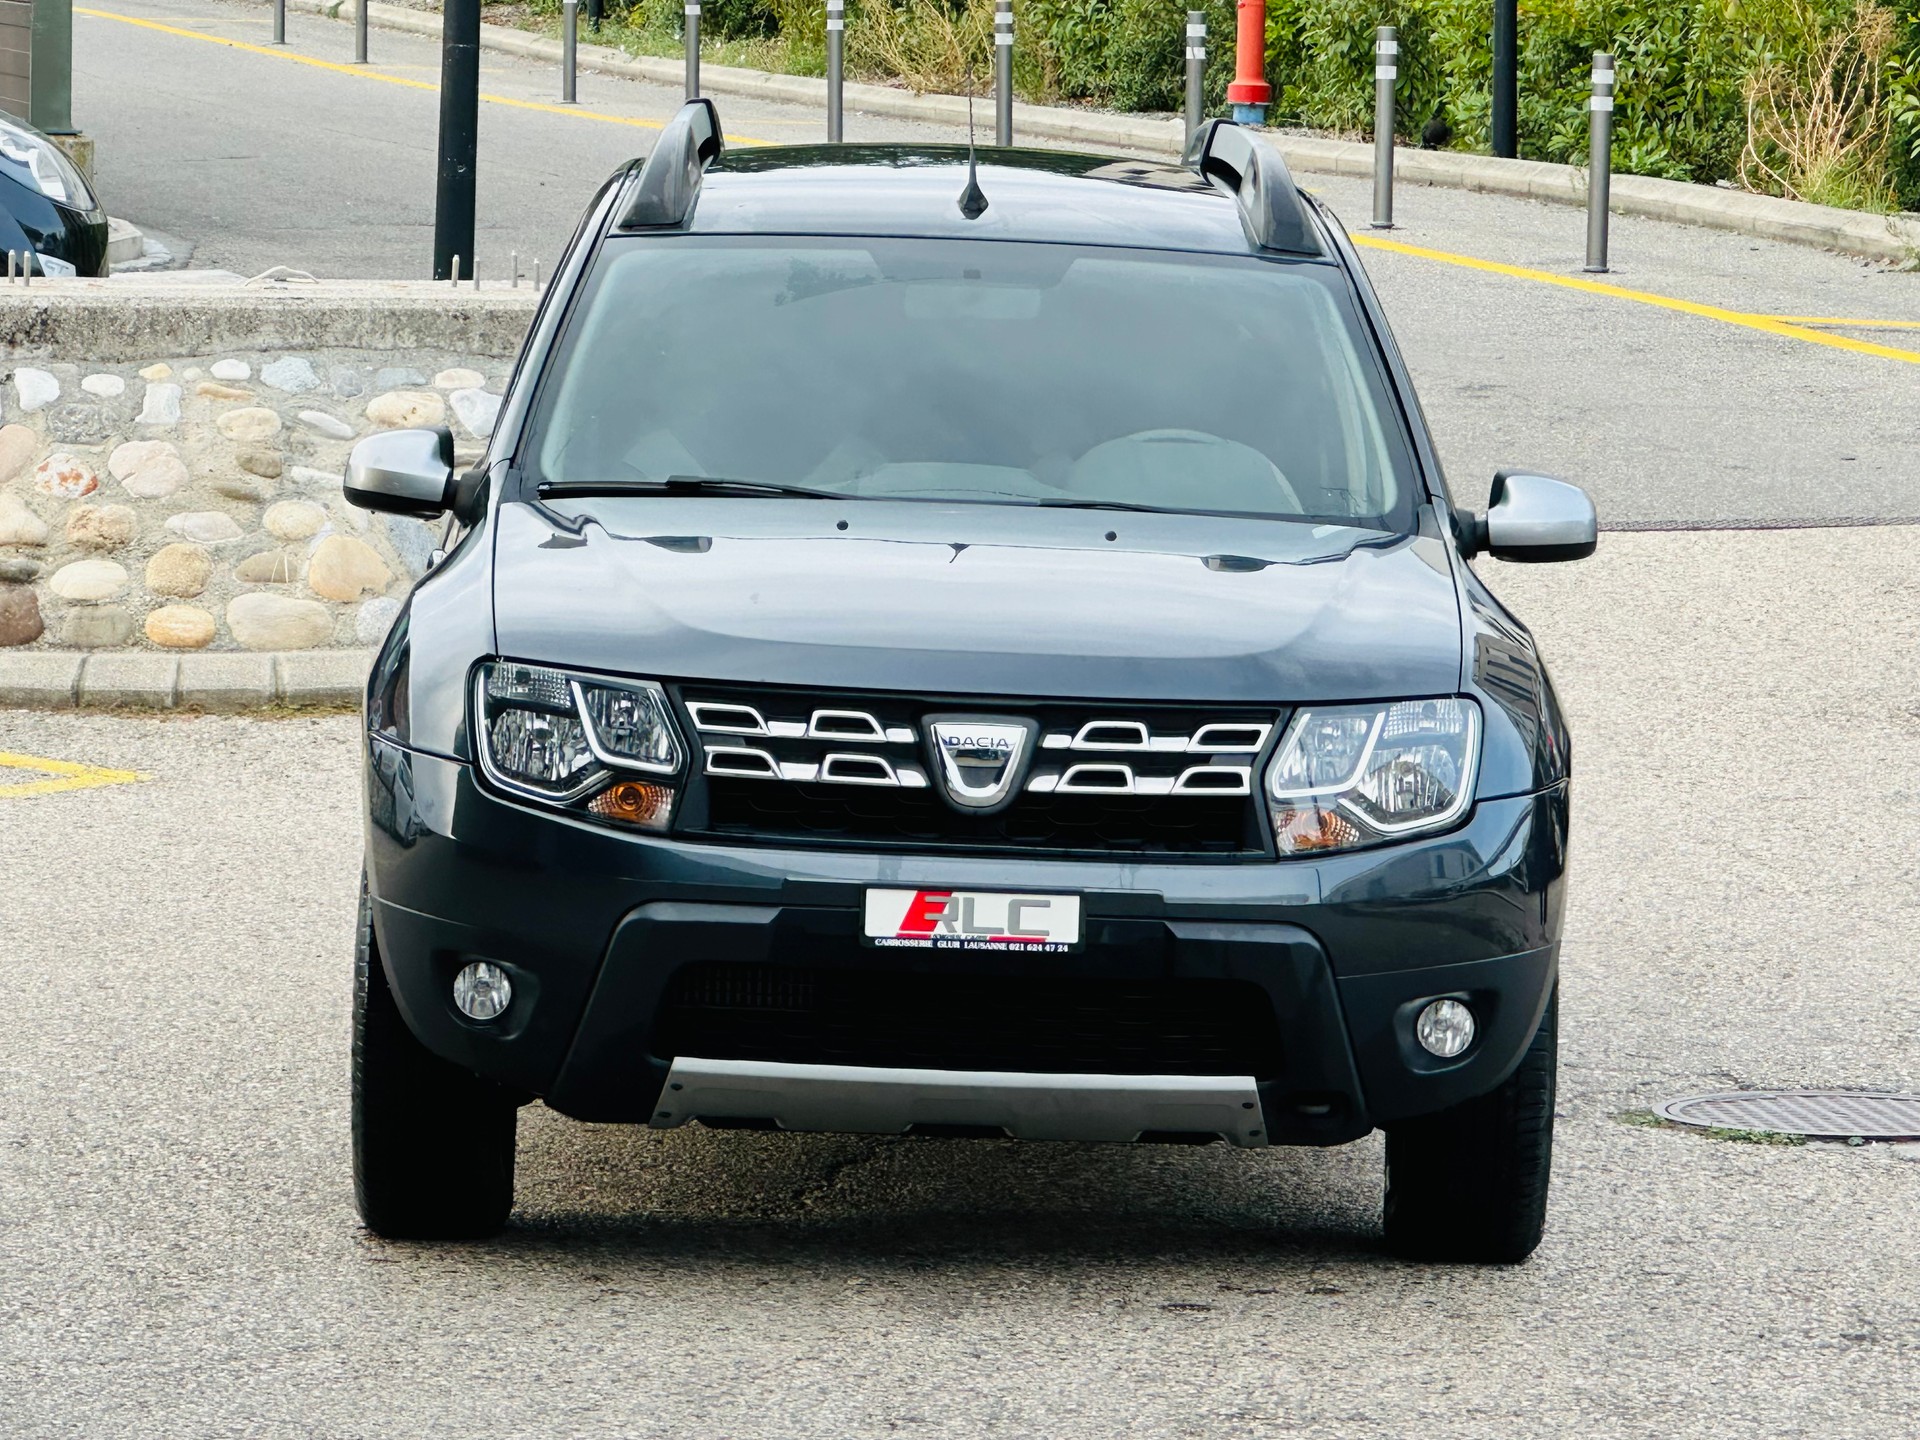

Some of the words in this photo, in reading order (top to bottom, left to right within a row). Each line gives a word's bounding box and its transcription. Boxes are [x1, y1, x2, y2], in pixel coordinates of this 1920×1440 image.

[948, 736, 1009, 749] DACIA
[874, 938, 934, 948] CARROSSERIE
[964, 941, 1008, 951] LAUSANNE
[1008, 943, 1025, 951] 021
[1027, 943, 1043, 952] 624
[1044, 944, 1056, 952] 47
[1057, 944, 1069, 953] 24
